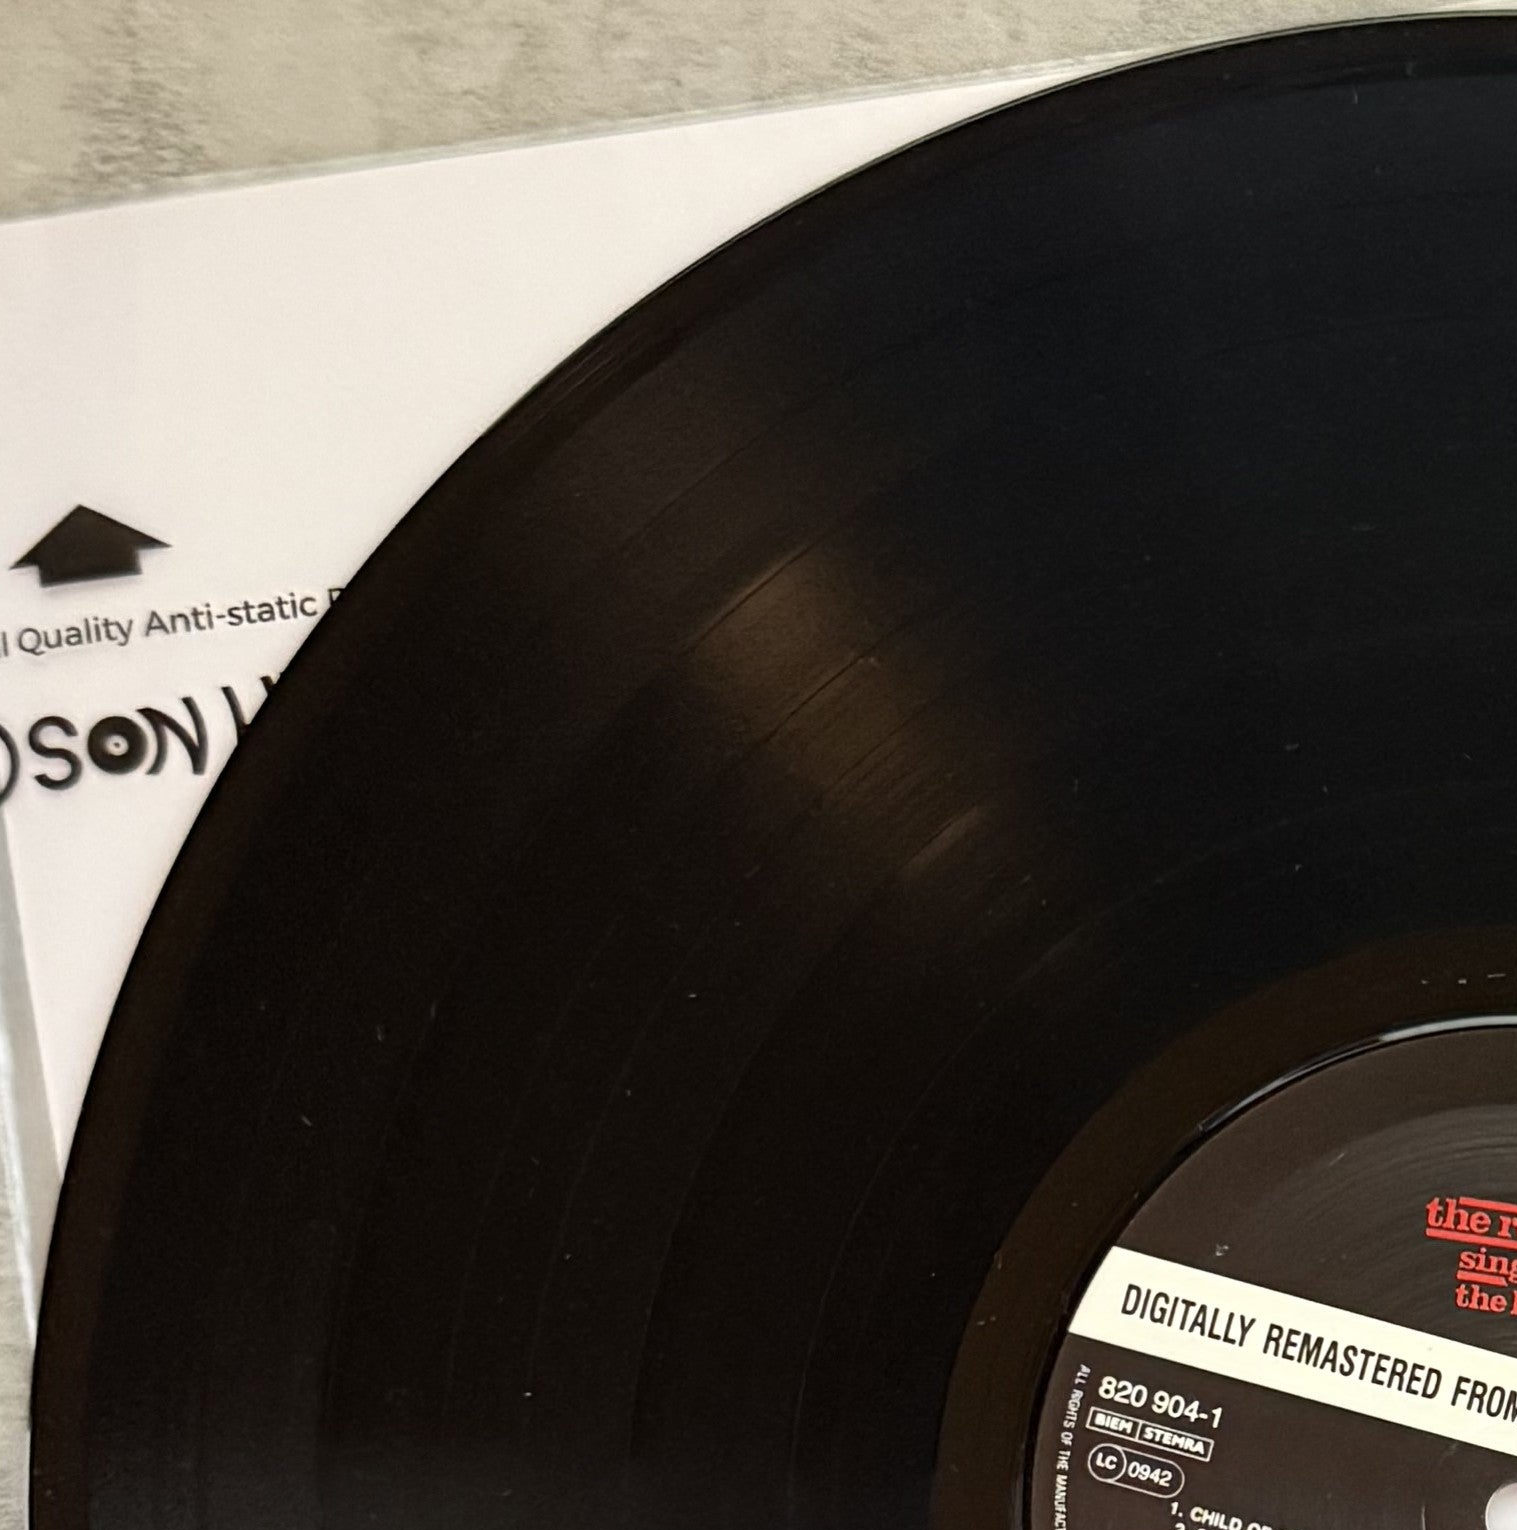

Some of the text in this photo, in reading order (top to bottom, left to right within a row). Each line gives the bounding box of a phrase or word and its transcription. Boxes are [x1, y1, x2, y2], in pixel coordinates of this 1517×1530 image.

[18, 618, 133, 656] Quality
[145, 593, 318, 637] Anti-static
[1426, 1197, 1491, 1232] the
[1455, 1284, 1507, 1313] the
[1120, 1283, 1256, 1347] DIGITALLY
[1262, 1322, 1442, 1399] REMASTERED
[1098, 1376, 1222, 1429] 820 904-1
[1094, 1412, 1205, 1455] BIEM STEMRA
[1096, 1452, 1173, 1487] LC 0942
[1170, 1501, 1183, 1517] 1.
